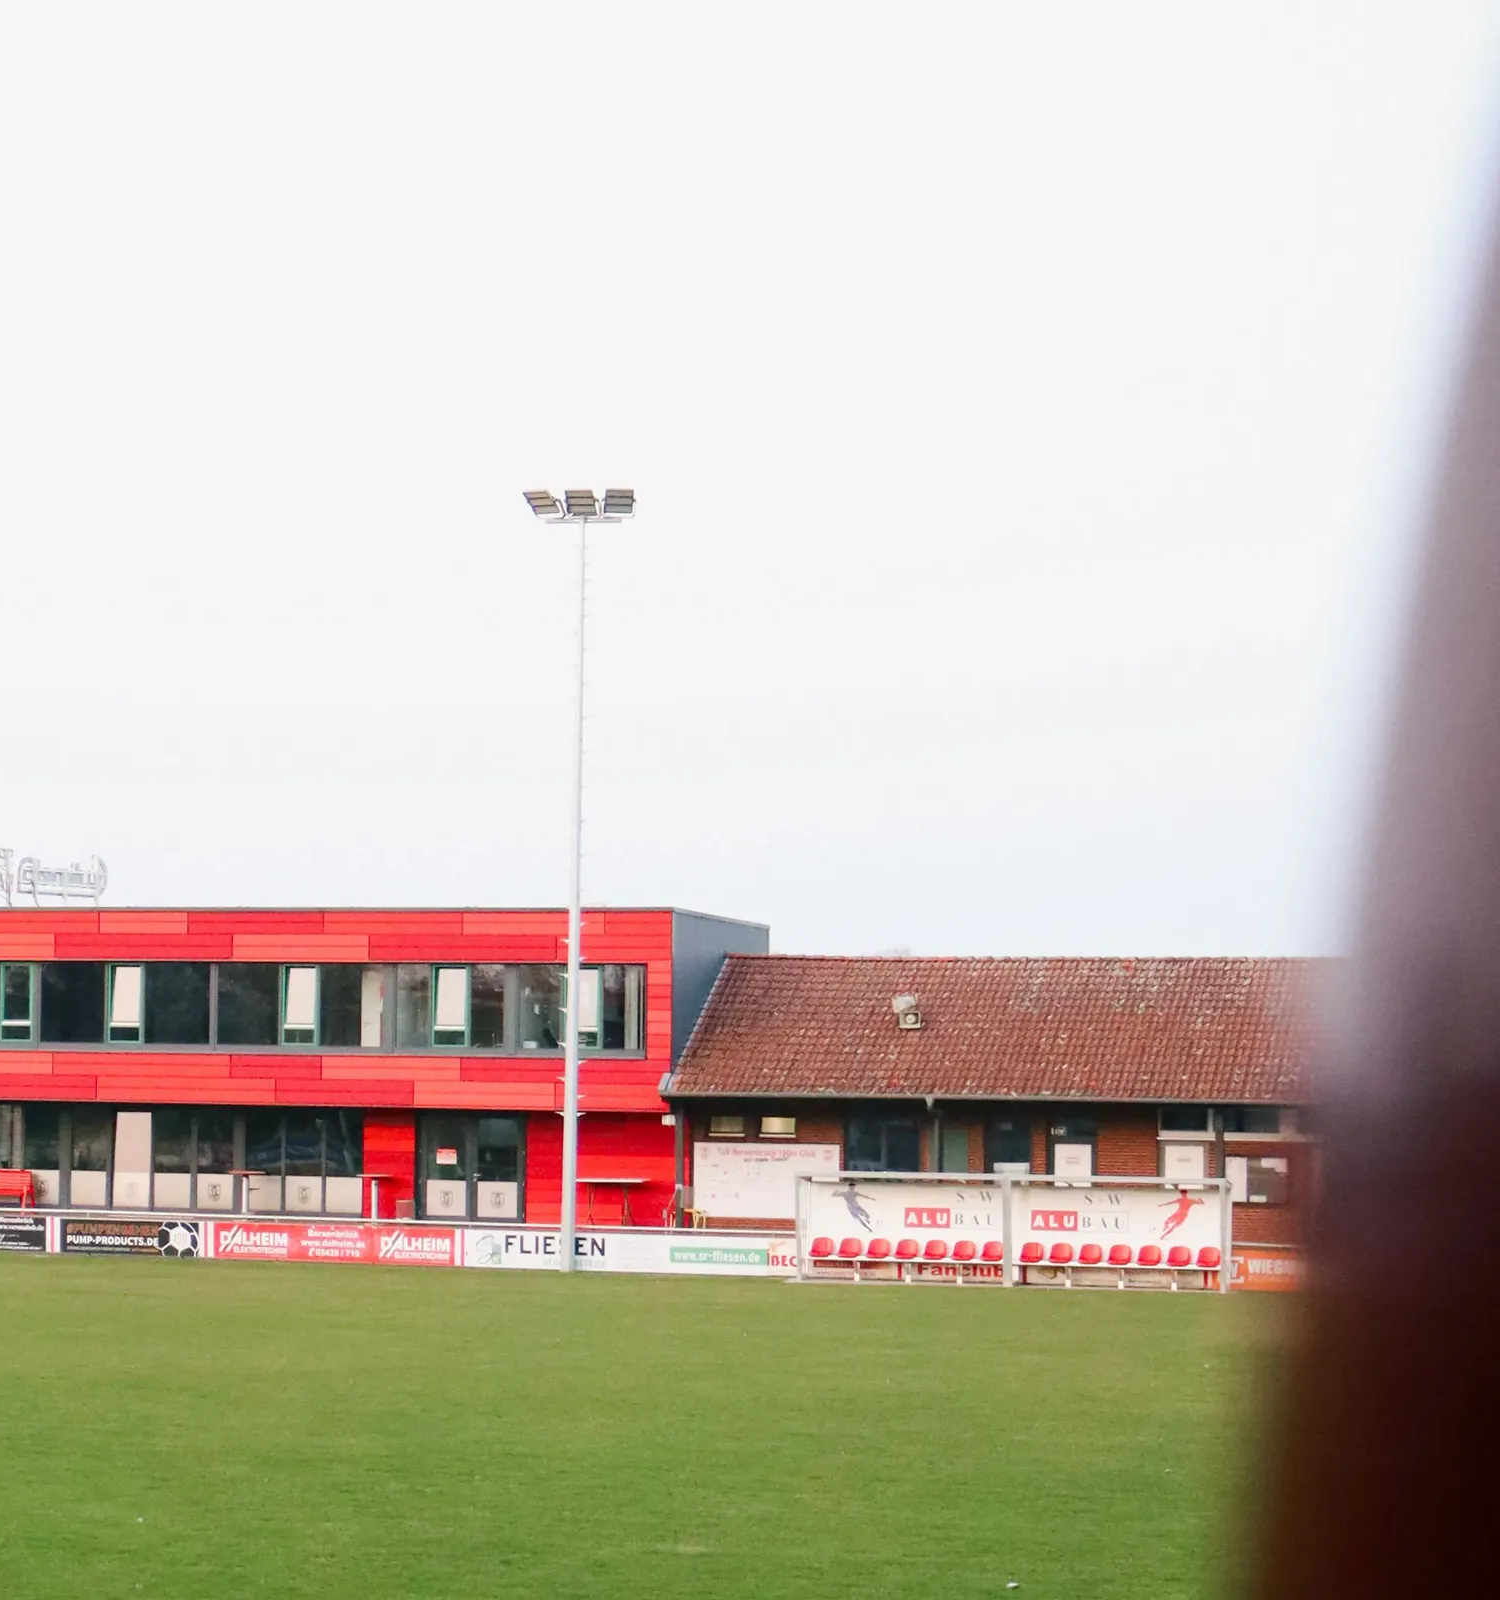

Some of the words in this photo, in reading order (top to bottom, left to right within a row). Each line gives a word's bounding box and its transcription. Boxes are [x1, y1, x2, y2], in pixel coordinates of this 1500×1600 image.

[906, 1211, 948, 1225] ALU
[1033, 1214, 1075, 1228] ALU
[1082, 1216, 1124, 1229] BAU
[66, 1234, 159, 1246] PUMP-PRODUCTS.DE
[219, 1225, 289, 1253] DALHEIM
[307, 1229, 359, 1239] Bersenbrück
[300, 1239, 366, 1249] www.dalheim.de
[378, 1229, 451, 1258] DALHEIM
[504, 1235, 606, 1257] FLIEEN
[674, 1250, 761, 1264] www.sr-fliesen.de
[771, 1255, 798, 1268] BEC
[917, 1263, 1004, 1278] Fanclub
